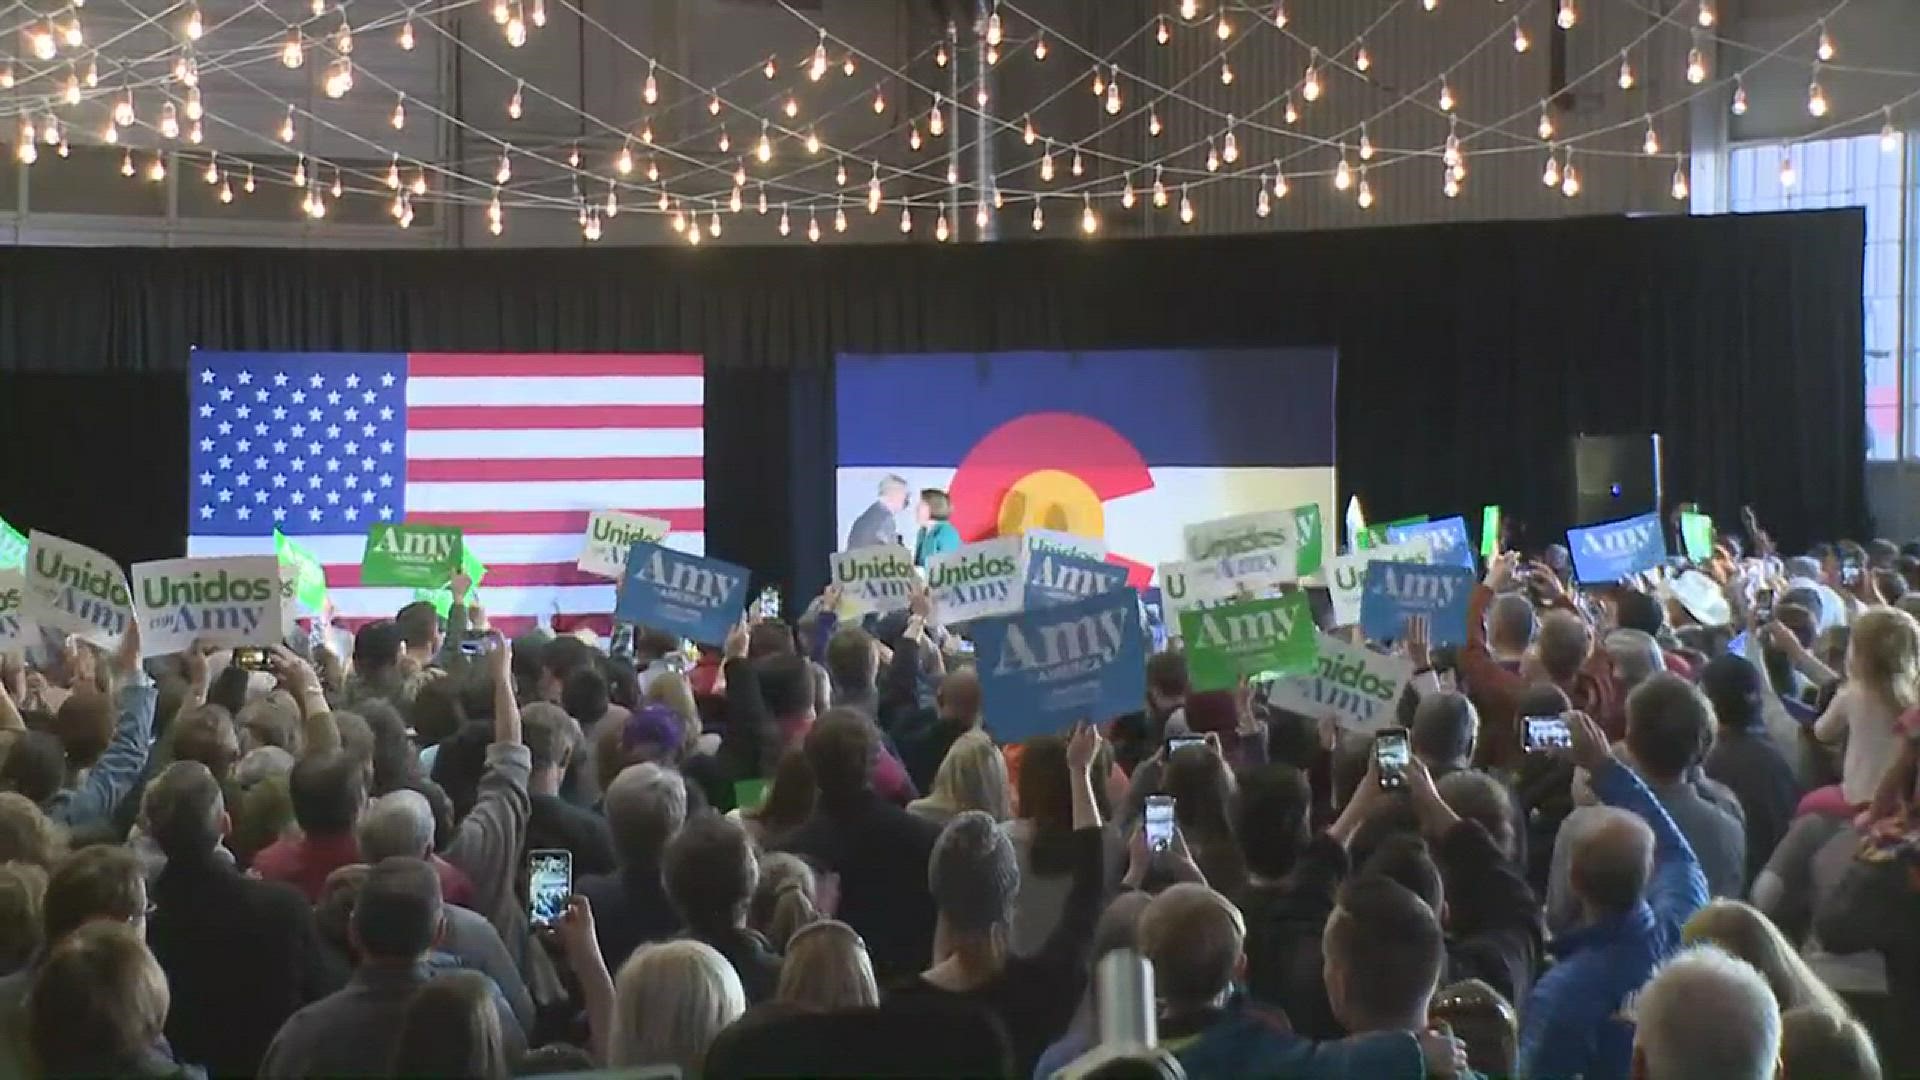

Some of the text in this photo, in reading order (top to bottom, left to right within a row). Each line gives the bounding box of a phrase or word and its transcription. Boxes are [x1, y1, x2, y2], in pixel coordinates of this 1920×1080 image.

[373, 526, 457, 561] Amy
[1581, 520, 1656, 555] Amy
[36, 547, 130, 606] Unido
[634, 550, 740, 608] Amy
[838, 553, 912, 583] Unido
[928, 553, 1015, 588] Unidos
[1032, 555, 1118, 599] Amy
[1372, 566, 1463, 608] Amy
[143, 569, 270, 608] Unidos
[951, 579, 1012, 607] Amy
[172, 604, 264, 635] Amy
[1195, 604, 1300, 648] Amy
[994, 607, 1128, 676] Amy
[1318, 654, 1396, 700] nidos
